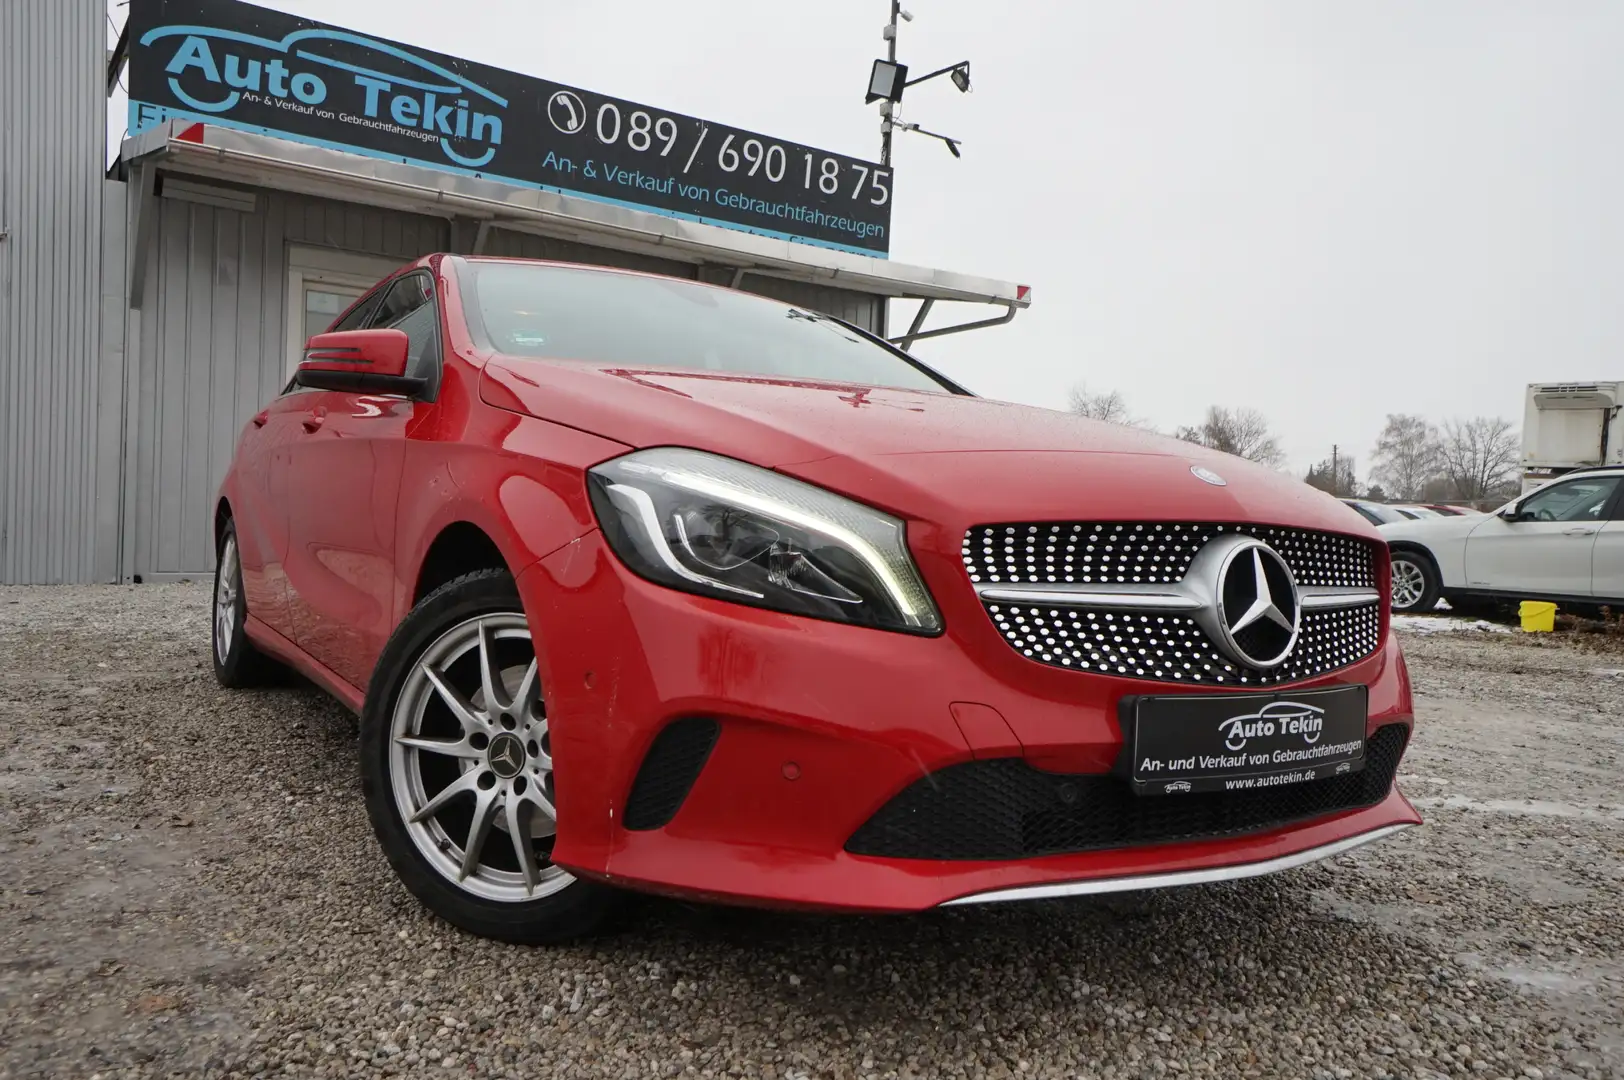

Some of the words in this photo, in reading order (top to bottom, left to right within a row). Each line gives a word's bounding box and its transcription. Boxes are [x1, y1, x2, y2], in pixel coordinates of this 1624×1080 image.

[165, 35, 327, 105] Auto
[355, 75, 503, 145] Tekin
[243, 91, 262, 102] An-
[263, 96, 273, 106] &
[275, 98, 314, 115] Verkauf
[316, 109, 335, 120] von
[339, 112, 440, 143] Gebrauchtfahrzeugen
[596, 103, 678, 157] 089
[683, 127, 709, 174] /
[718, 134, 787, 183] 690
[804, 153, 839, 195] 18
[851, 164, 890, 206] 75
[542, 151, 578, 173] An-
[583, 159, 597, 179] &
[603, 163, 675, 194] Verkauf
[678, 183, 710, 202] von
[714, 188, 884, 238] Gebrauchtfahrzeugen
[1228, 720, 1275, 739] Auto
[1279, 714, 1323, 735] Tekin
[1140, 757, 1165, 772] An-
[1168, 756, 1196, 770] und
[1199, 753, 1247, 769] Verkauf
[1249, 754, 1270, 766] von
[1272, 739, 1362, 763] Gebrauchtfahrzeugen
[1225, 770, 1316, 790] www.autotekin.de
